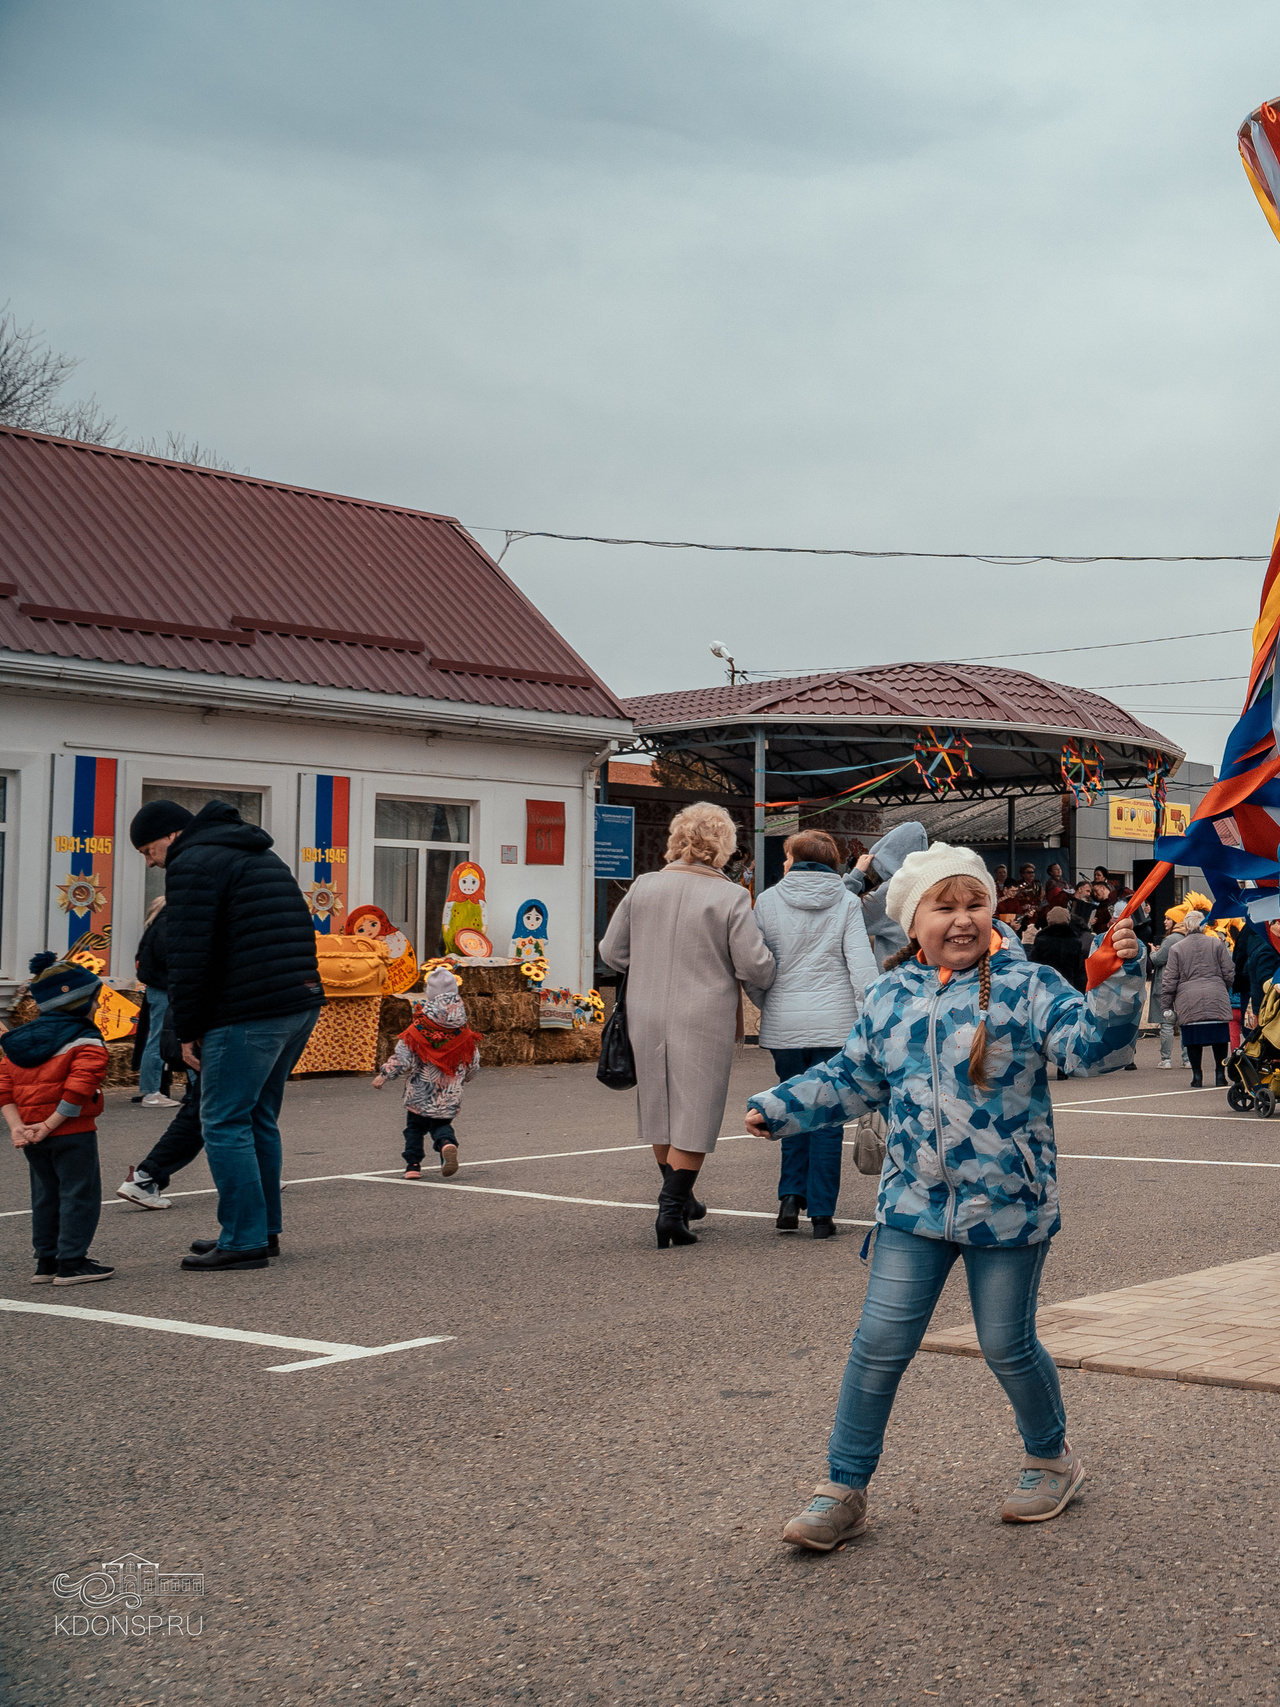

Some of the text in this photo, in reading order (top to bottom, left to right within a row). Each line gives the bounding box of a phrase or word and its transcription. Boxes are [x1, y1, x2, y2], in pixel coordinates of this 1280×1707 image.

[1117, 806, 1160, 828] ИГРУШ
[54, 836, 112, 854] 1941-1945
[536, 828, 552, 851] 61
[301, 847, 347, 864] 1941-1945
